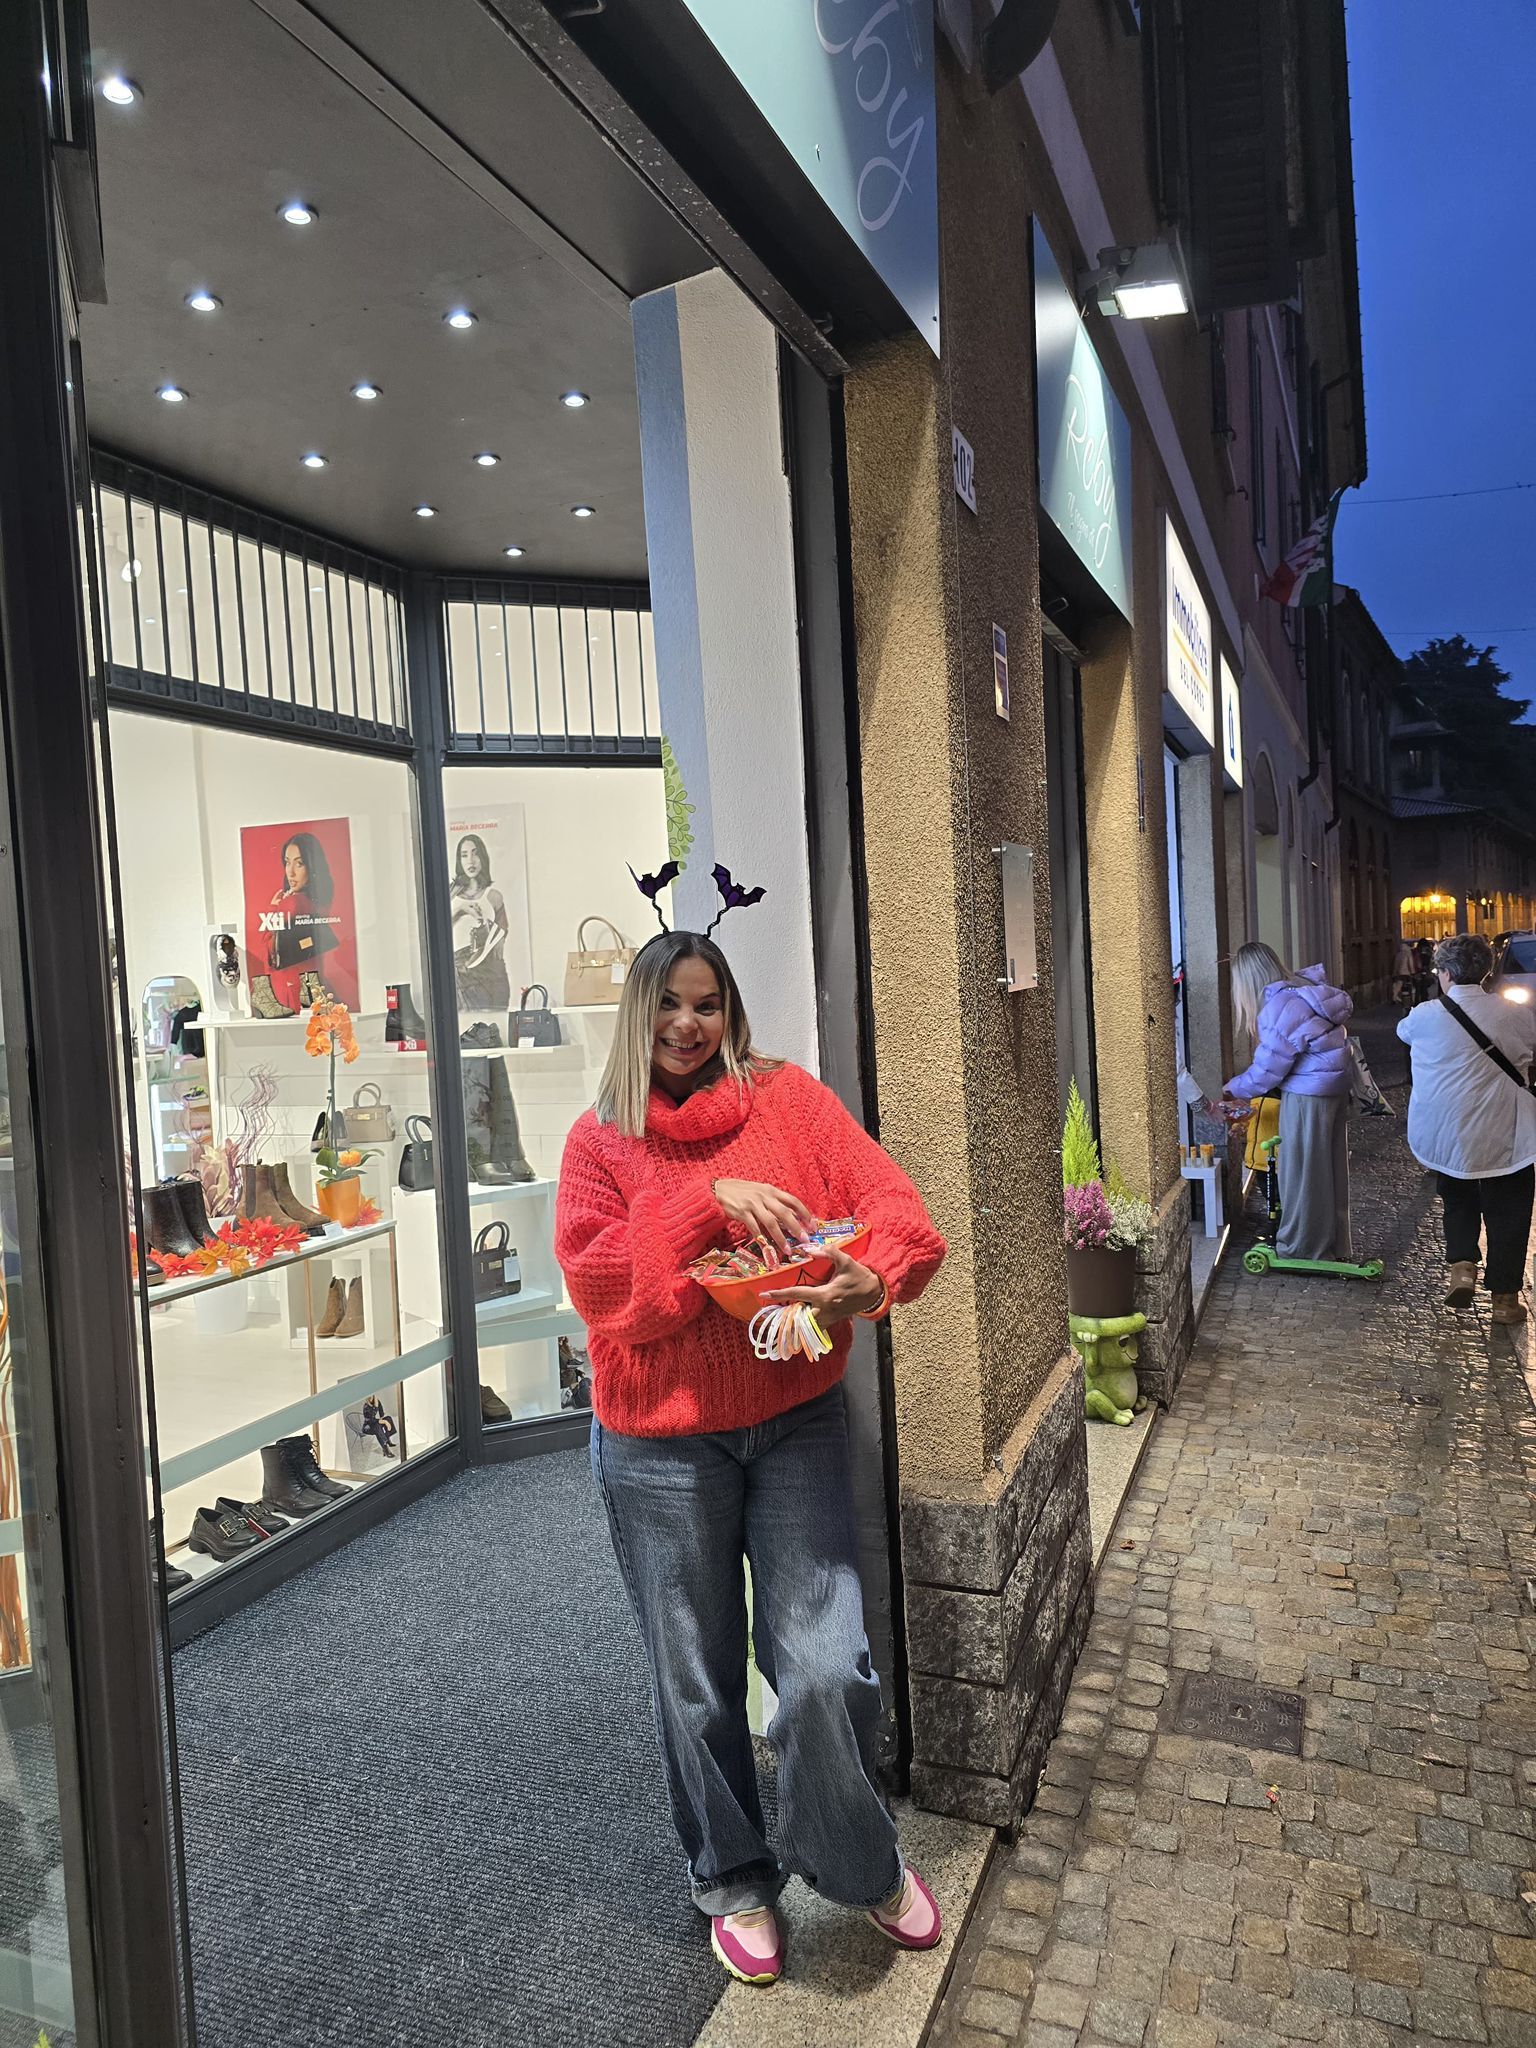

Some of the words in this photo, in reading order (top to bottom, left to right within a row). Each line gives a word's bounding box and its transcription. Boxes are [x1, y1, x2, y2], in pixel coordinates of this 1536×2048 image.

[955, 437, 973, 500] 102
[1065, 374, 1115, 568] Reby
[258, 911, 286, 931] Xti
